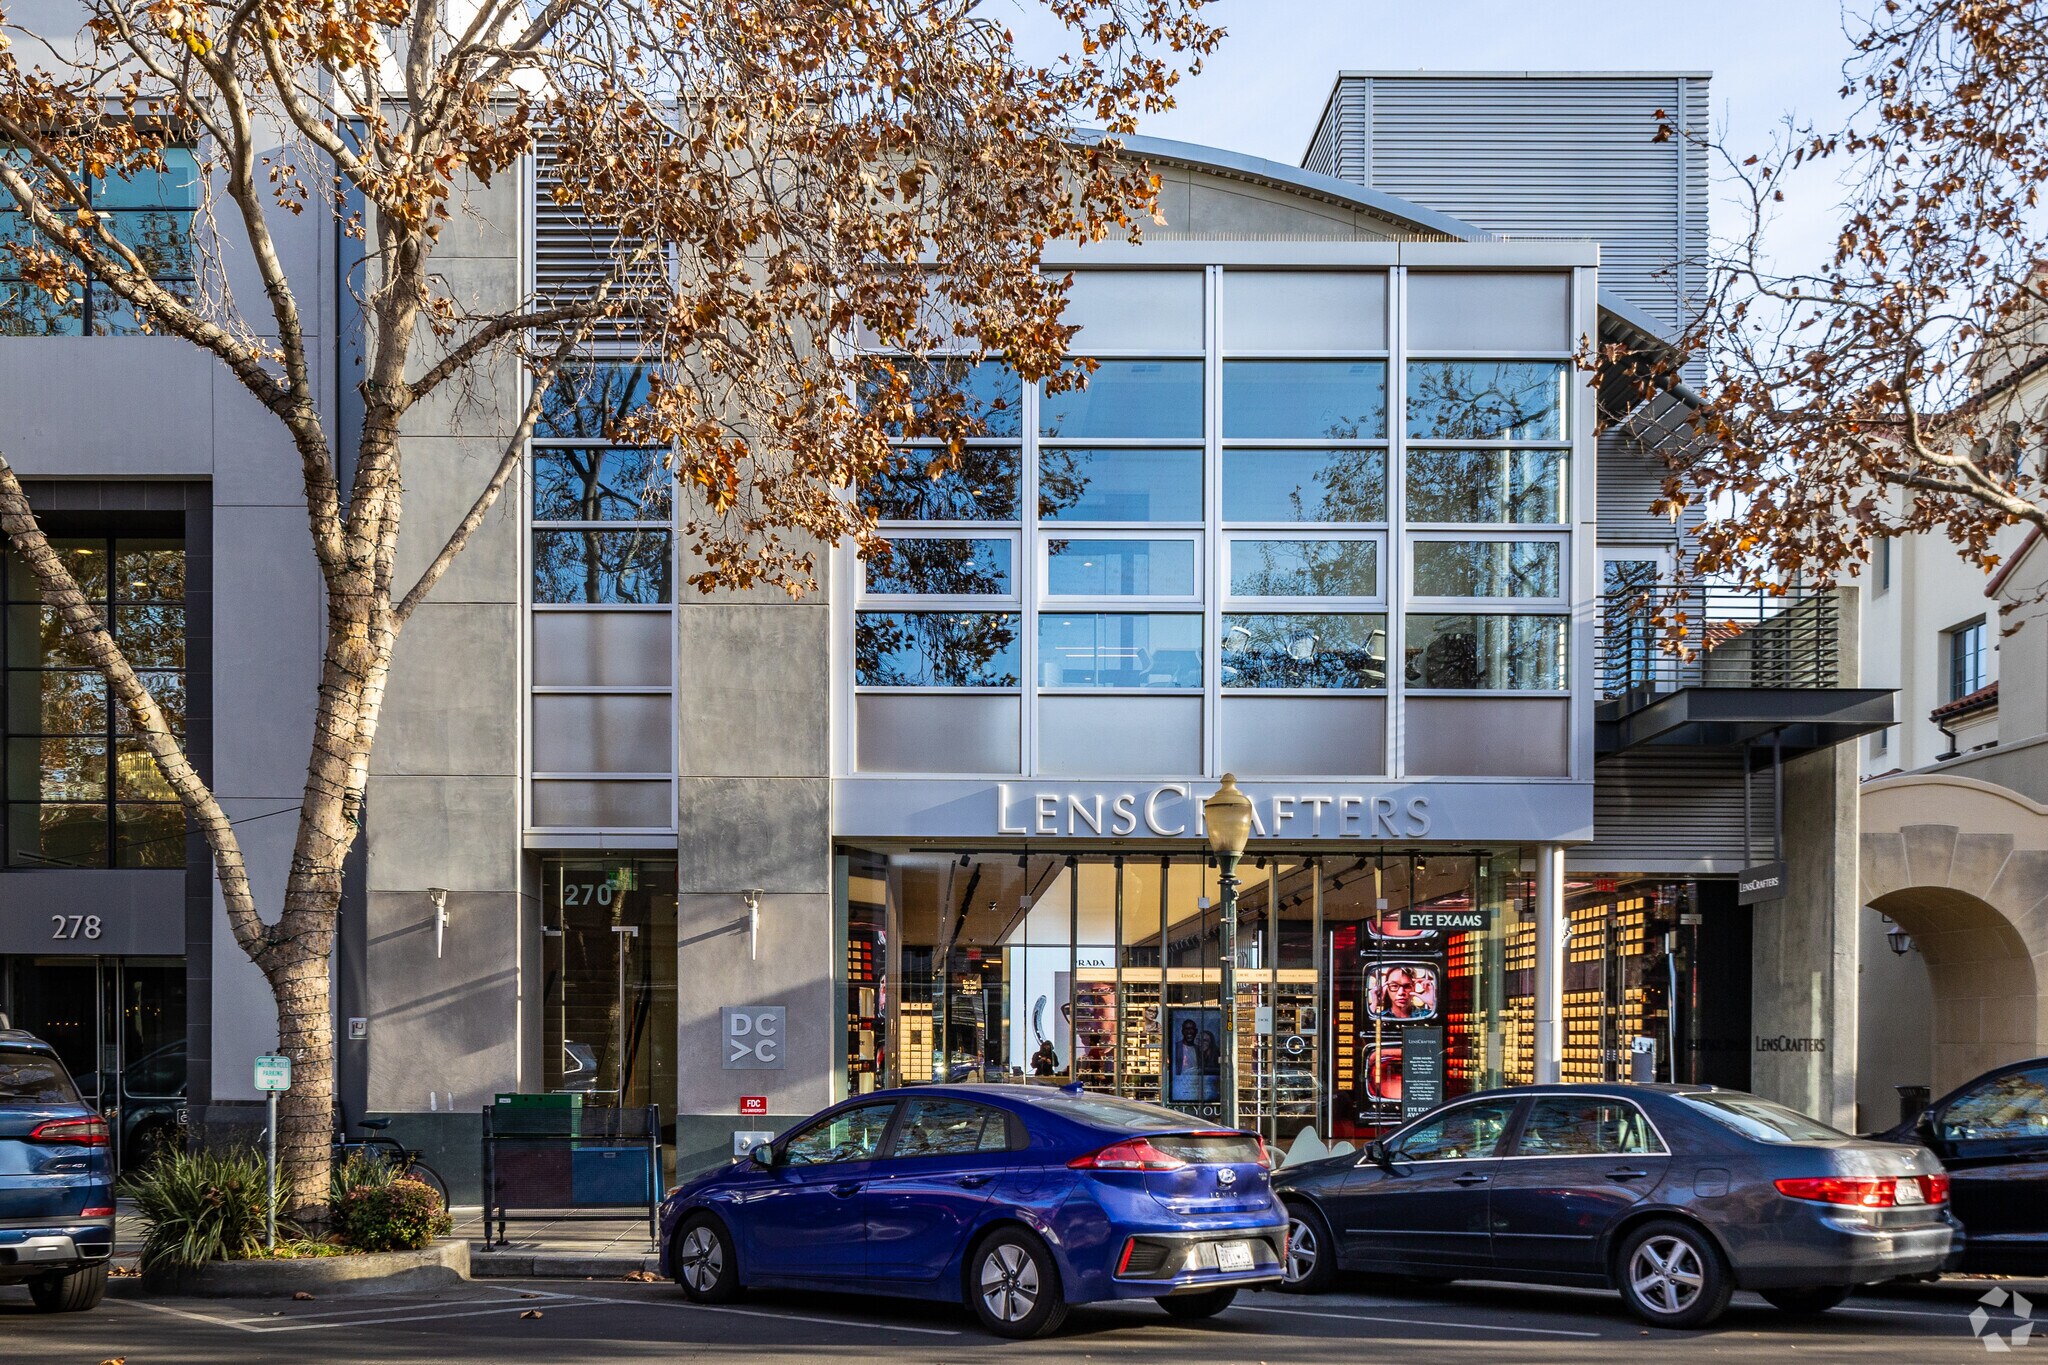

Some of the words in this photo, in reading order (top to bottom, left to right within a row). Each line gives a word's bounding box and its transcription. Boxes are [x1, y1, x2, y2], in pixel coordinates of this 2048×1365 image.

[565, 884, 612, 905] 270
[52, 915, 101, 939] 278
[1410, 915, 1433, 926] EYE
[1436, 915, 1482, 926] EXAMS
[746, 1099, 761, 1107] FDC
